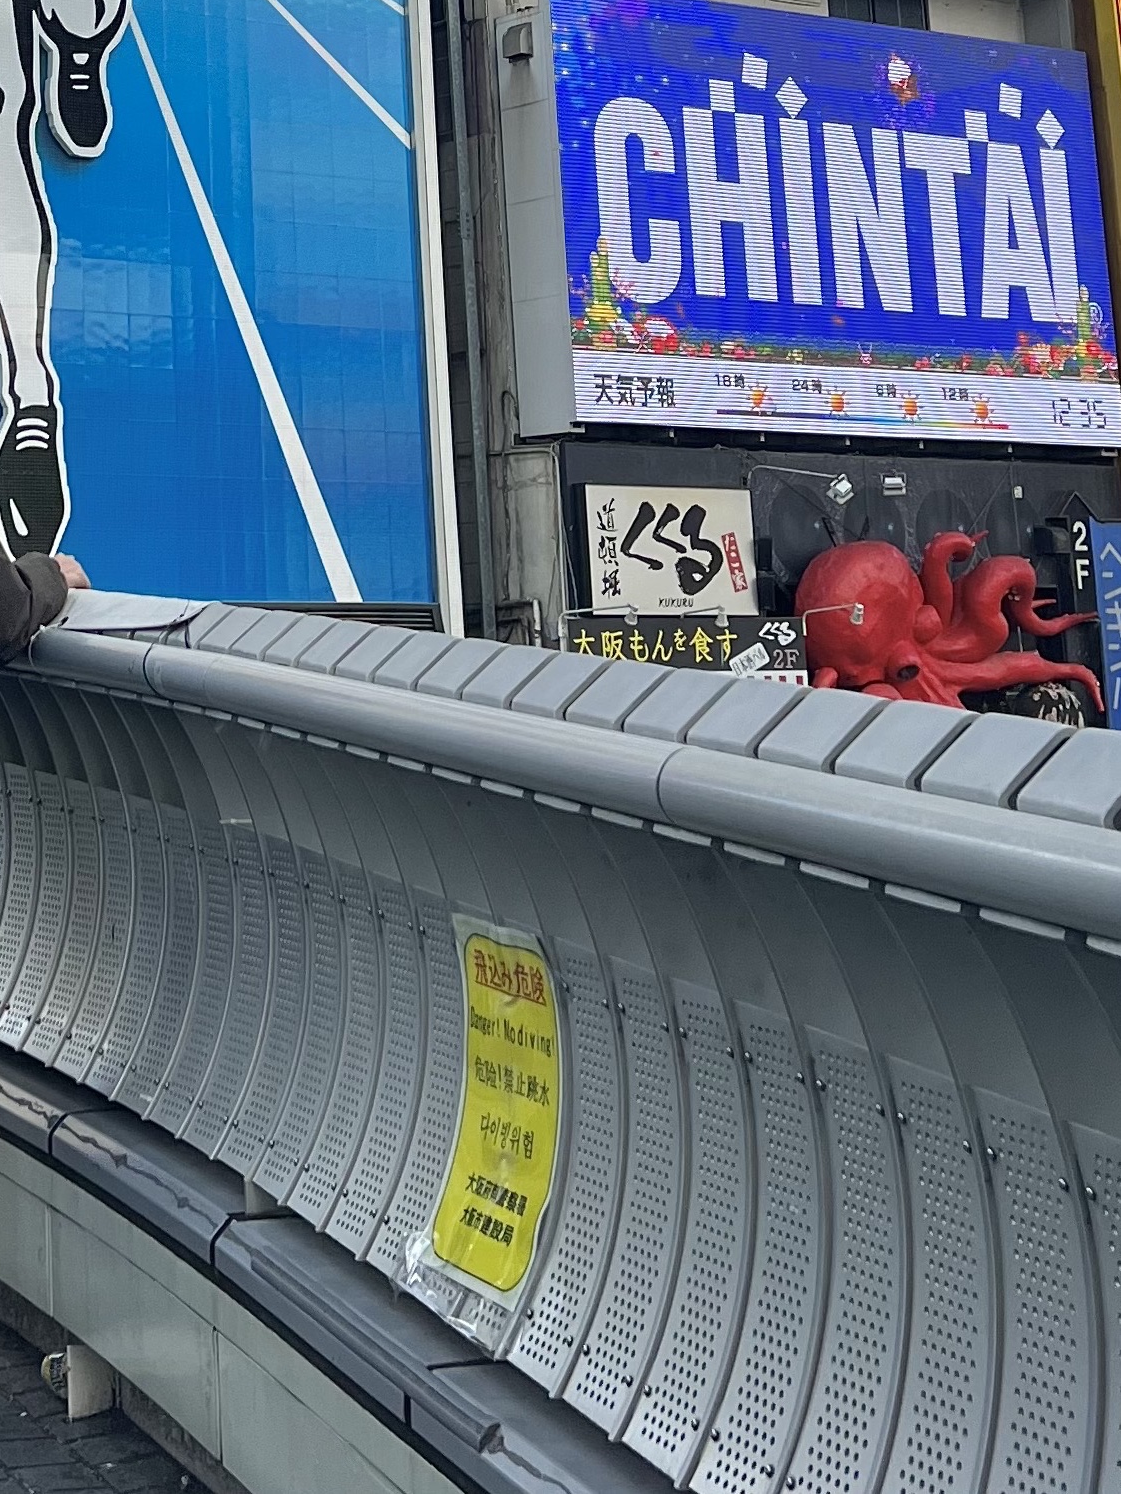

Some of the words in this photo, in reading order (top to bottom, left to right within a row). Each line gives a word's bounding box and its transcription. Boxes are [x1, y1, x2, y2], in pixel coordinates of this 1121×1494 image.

[593, 53, 1079, 324] CHINTAI
[594, 373, 677, 408] 天気予報
[620, 501, 724, 596] くくる
[658, 597, 694, 608] KUKURU
[773, 649, 800, 669] 2F
